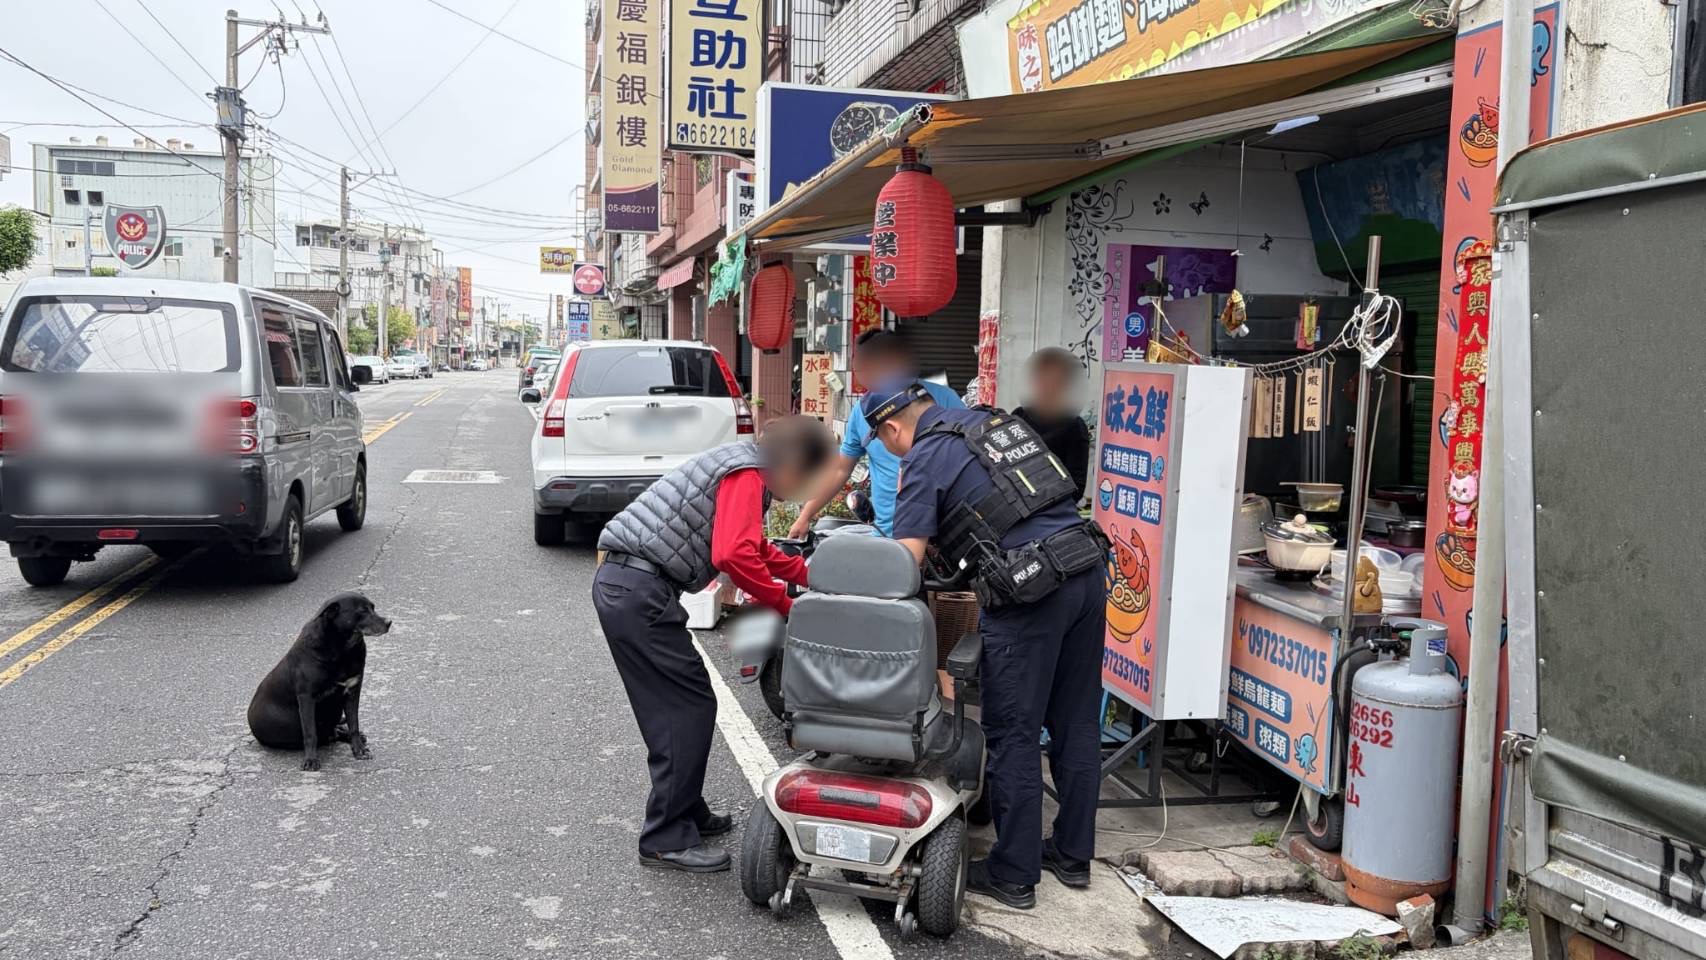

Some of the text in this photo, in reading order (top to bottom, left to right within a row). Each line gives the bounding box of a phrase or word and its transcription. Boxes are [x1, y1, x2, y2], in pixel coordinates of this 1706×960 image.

[1018, 24, 1043, 92] 味之
[616, 0, 648, 148] 慶福銀樓
[611, 164, 653, 175] Diamond
[612, 155, 634, 163] Gold
[607, 203, 656, 215] 05-6622117
[117, 243, 148, 256] POLICE
[1127, 317, 1142, 333] 男
[1455, 262, 1493, 464] 家興人興萬事興
[1104, 383, 1169, 442] 味之鮮
[990, 423, 1029, 448] 警察
[1004, 441, 1040, 463] POLICE
[1117, 489, 1137, 514] 飯類
[1141, 495, 1161, 521] 粥類
[1012, 560, 1042, 584] POLICE
[1248, 623, 1328, 686] 0972337015
[1225, 706, 1245, 736] 類
[1258, 723, 1287, 760] 粥類
